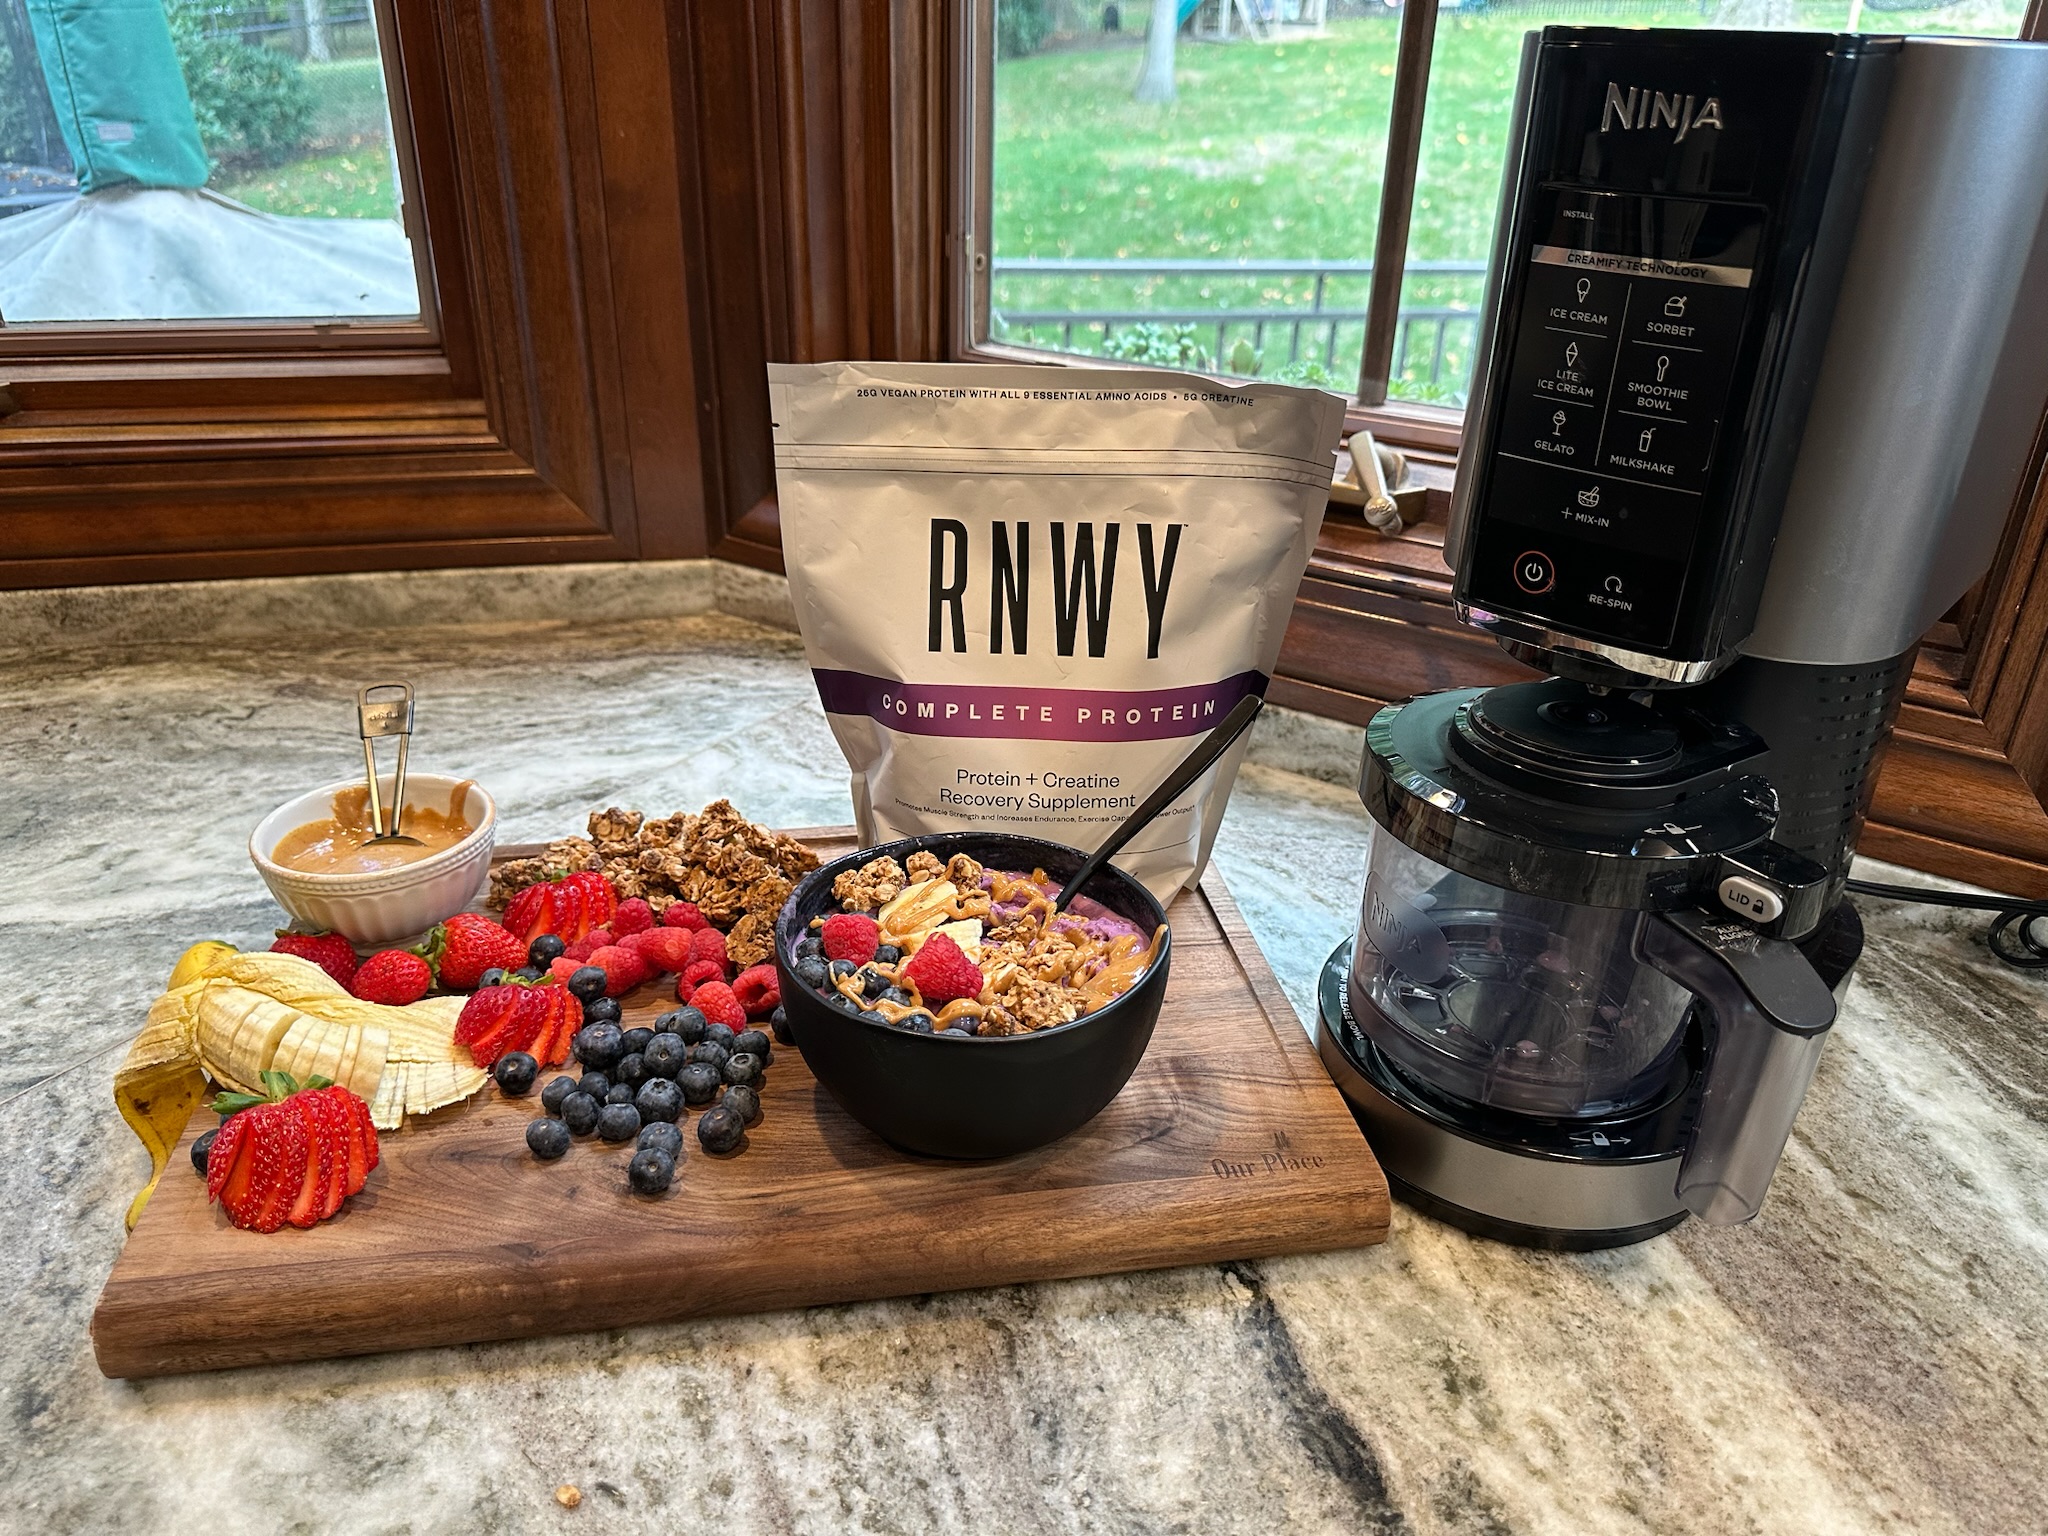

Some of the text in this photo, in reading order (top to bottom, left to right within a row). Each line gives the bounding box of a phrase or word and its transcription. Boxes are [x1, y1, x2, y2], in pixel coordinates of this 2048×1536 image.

[1600, 81, 1724, 145] NINJA
[1563, 209, 1595, 221] INSTALL
[1567, 252, 1708, 279] CREAMIFY TECHNOLOGY
[1550, 307, 1608, 326] ICE CREAM
[1646, 321, 1696, 338] SORBET
[1556, 369, 1579, 382] LITE
[880, 388, 917, 399] VEGAN
[920, 389, 966, 399] PROTEIN
[969, 389, 997, 400] WITH
[1000, 390, 1020, 400] ALL
[1023, 390, 1030, 400] 9
[1033, 390, 1092, 401] ESSENTIAL
[1095, 391, 1131, 401] AMINO
[1133, 391, 1167, 401] ACIDS
[1201, 392, 1254, 407] CREATINE
[1537, 378, 1594, 398] ICE CREAM
[1627, 381, 1689, 400] SMOOTHIE
[1637, 396, 1673, 412] BOWL
[1534, 439, 1575, 456] GELATO
[1609, 454, 1676, 475] MILKSHAKE
[1575, 512, 1610, 528] MIX-IN
[928, 517, 1182, 659] RNWY
[1589, 593, 1633, 612] RE-SPIN
[882, 693, 1215, 725] COMPLETE PROTEIN
[957, 768, 1021, 787] Protein
[1043, 771, 1120, 788] Creatine
[940, 787, 1136, 812] Recovery Supplement
[895, 797, 923, 812] Promotes
[923, 806, 948, 816] Muscle
[949, 809, 980, 821] Strength
[996, 814, 1033, 822] Increases
[1034, 815, 1077, 824] Endurance,
[1078, 815, 1110, 823] Exercise
[1728, 889, 1750, 906] LID
[1371, 891, 1421, 954] NINJA
[1339, 991, 1353, 1020] RELEASE
[1346, 1020, 1365, 1041] BOWL
[1211, 1152, 1326, 1180] Our Place
